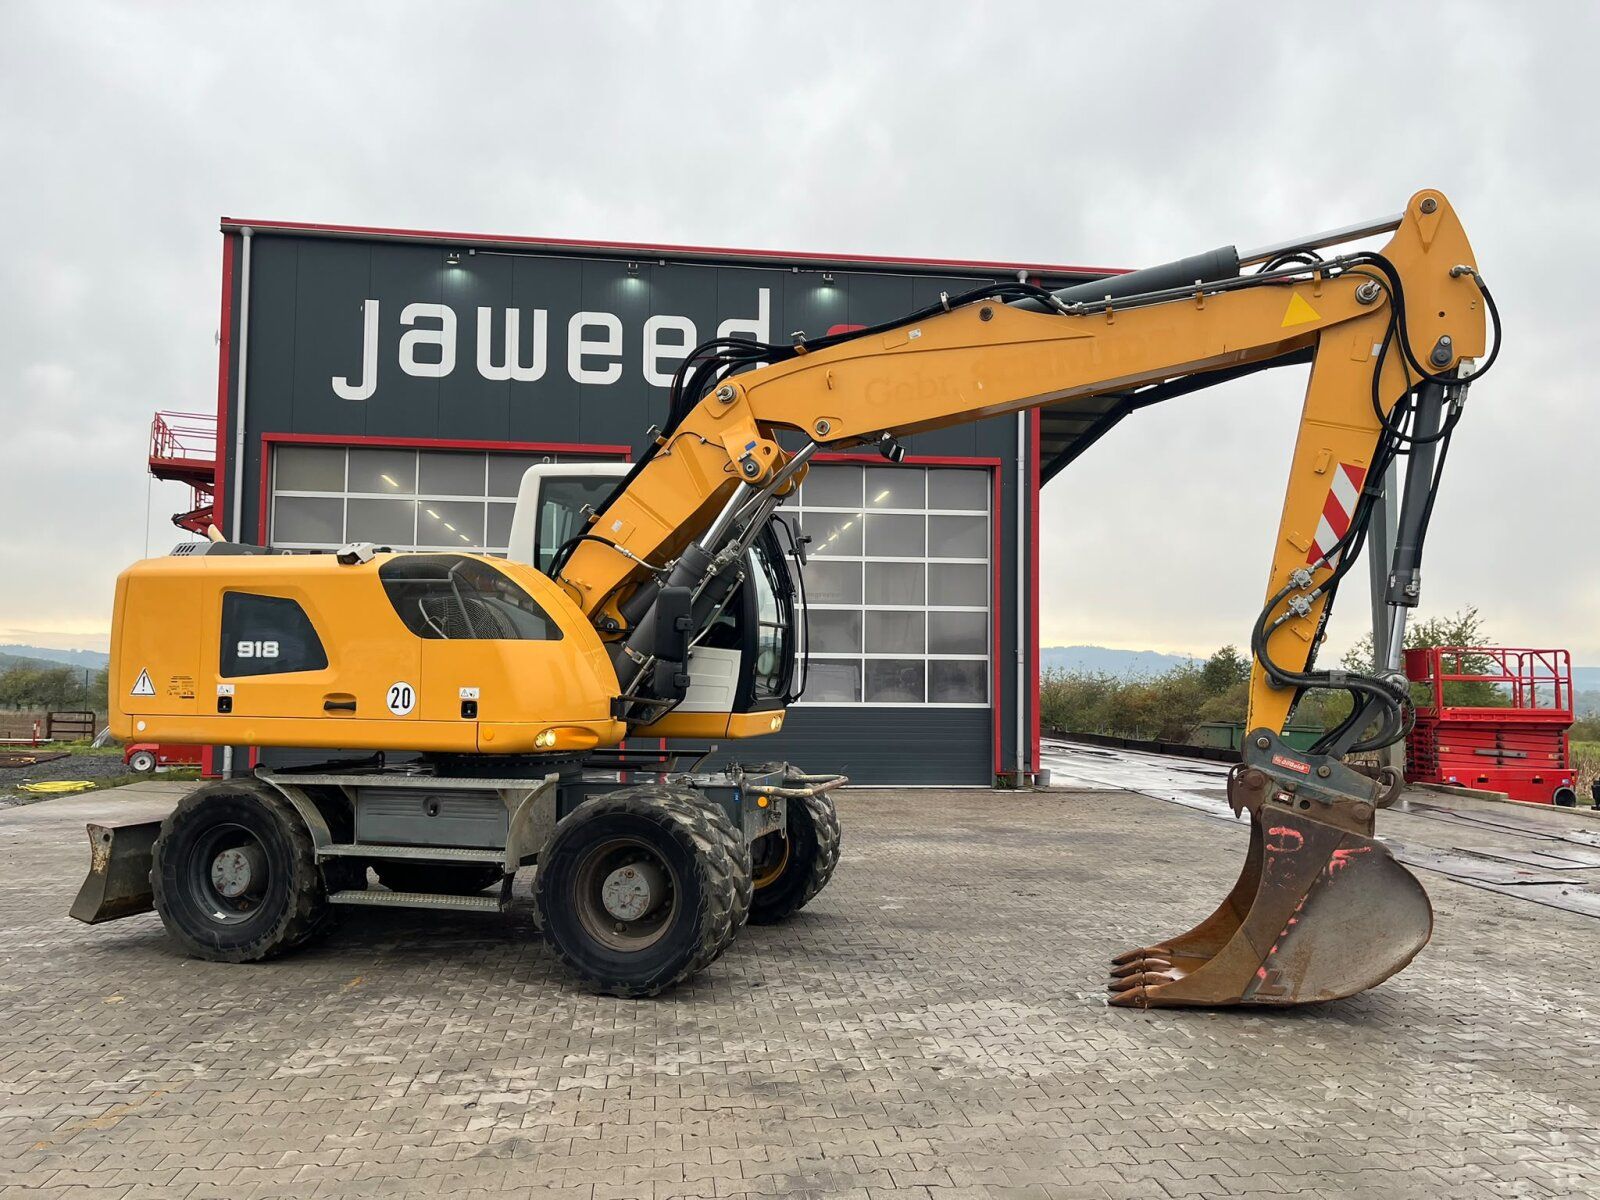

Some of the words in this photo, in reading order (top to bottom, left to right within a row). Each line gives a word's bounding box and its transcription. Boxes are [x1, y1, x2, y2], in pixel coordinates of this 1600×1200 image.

[332, 288, 770, 401] jaweed
[237, 640, 280, 658] 918
[391, 687, 411, 709] 20
